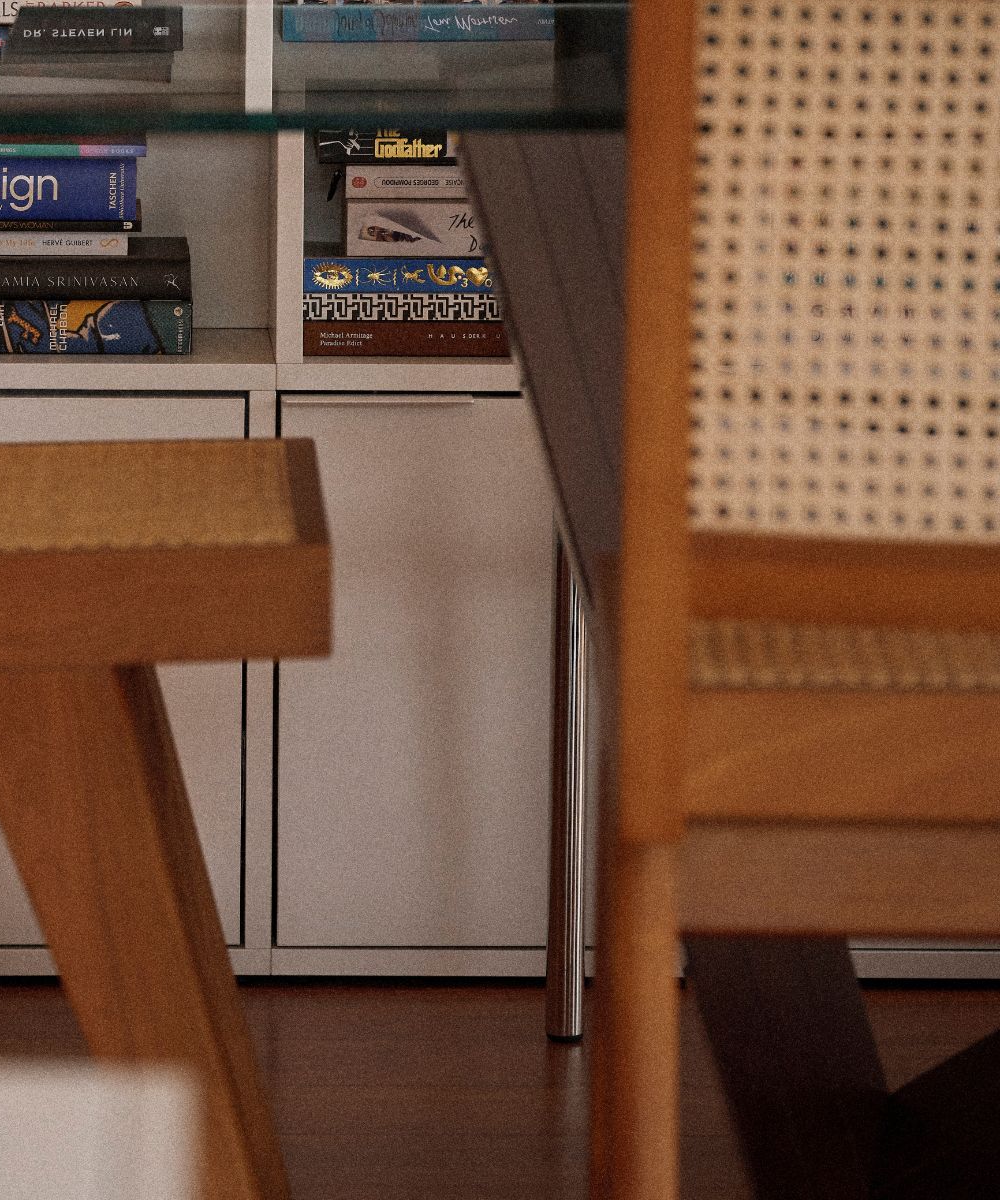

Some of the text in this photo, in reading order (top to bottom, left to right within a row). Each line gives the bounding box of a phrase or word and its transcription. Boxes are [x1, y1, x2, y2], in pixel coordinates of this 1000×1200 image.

[375, 137, 443, 159] Godfather
[109, 171, 118, 210] TASCHEN
[381, 179, 439, 187] GEORGES POMPIDOU
[447, 212, 475, 232] The
[42, 238, 63, 246] HERVÉ
[1, 276, 140, 288] AMIA SRINIVASAN
[49, 304, 58, 352] MICHAEL
[58, 304, 68, 352] CHABON
[319, 332, 374, 340] Michael Armitage
